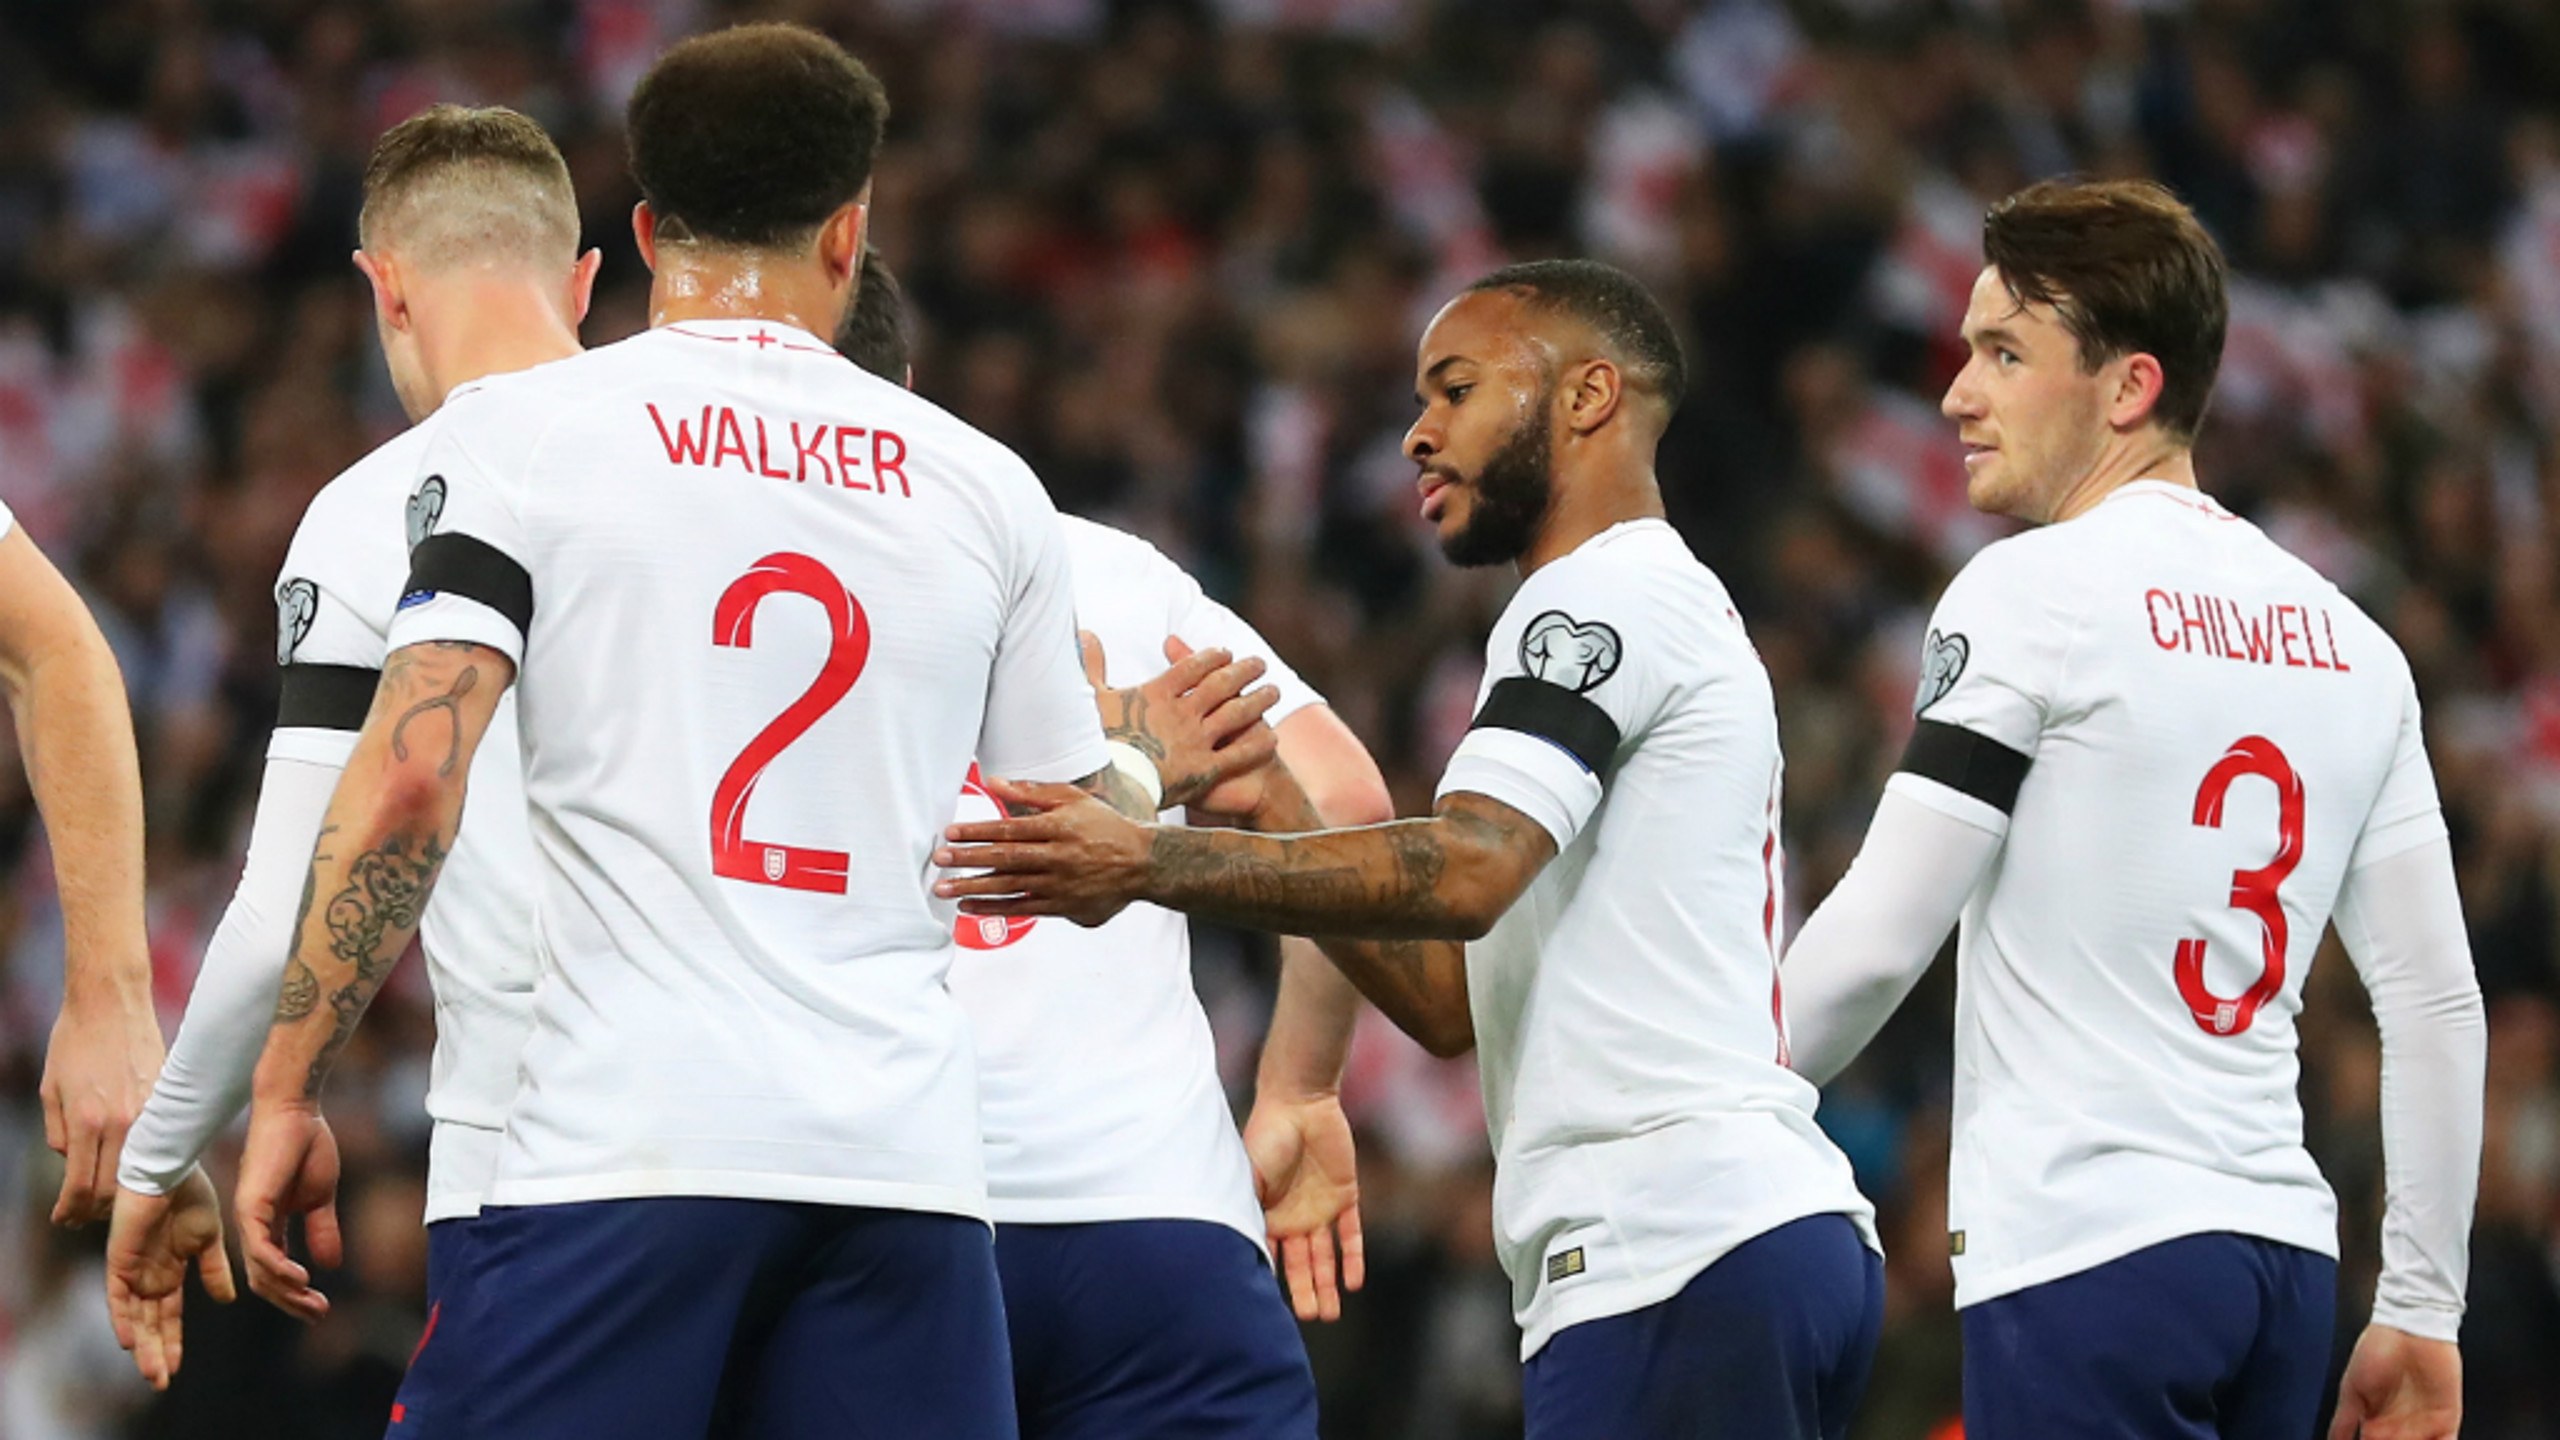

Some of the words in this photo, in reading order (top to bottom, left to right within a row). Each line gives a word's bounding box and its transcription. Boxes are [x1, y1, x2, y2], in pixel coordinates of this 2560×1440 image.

[647, 402, 911, 498] WALKER
[710, 551, 871, 896] 2
[2146, 588, 2351, 673] CHILWELL
[2173, 735, 2305, 1037] 3
